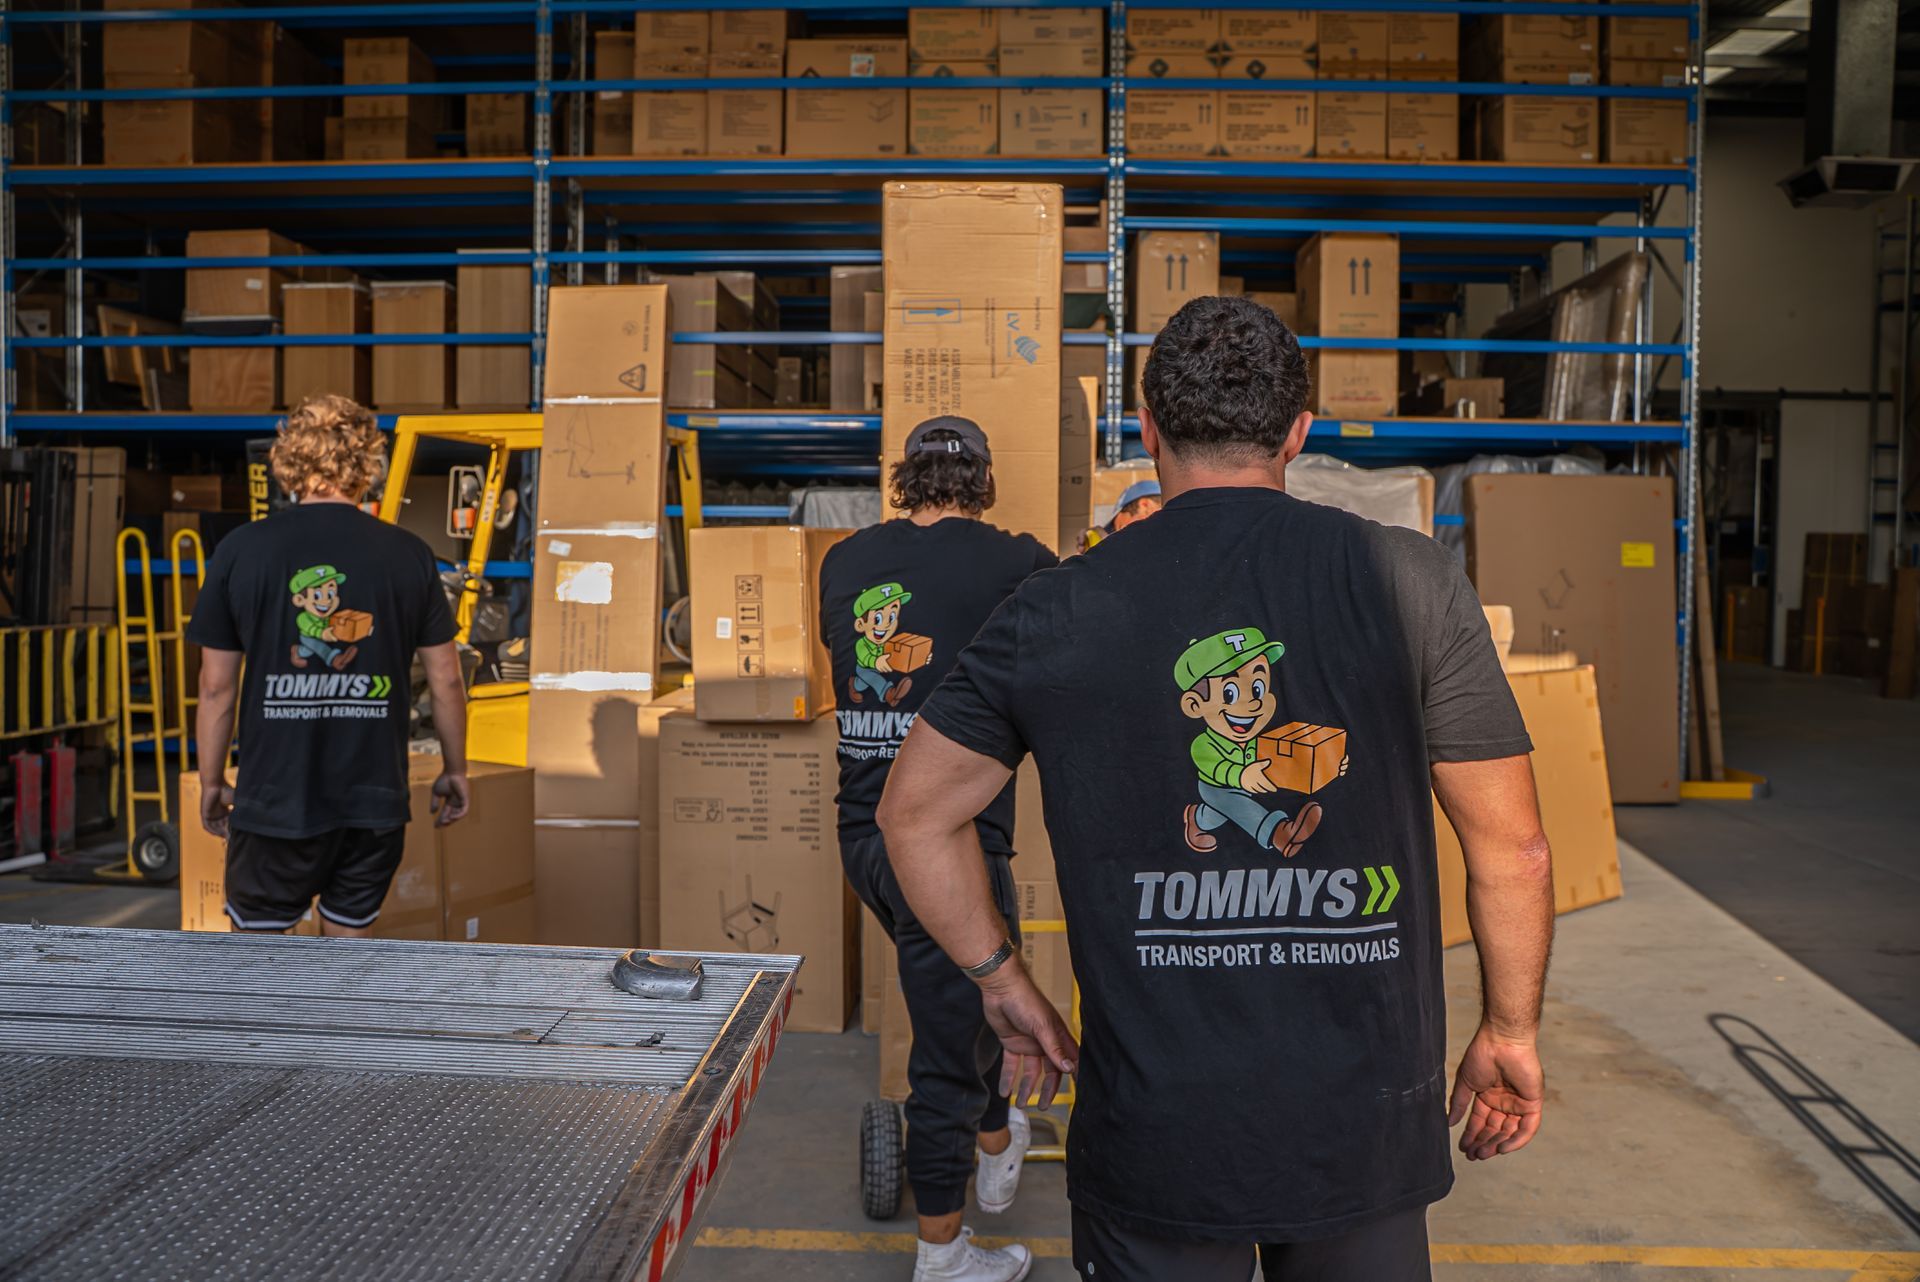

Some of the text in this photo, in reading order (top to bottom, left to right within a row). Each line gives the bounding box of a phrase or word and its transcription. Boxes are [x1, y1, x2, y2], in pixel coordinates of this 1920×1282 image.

[1007, 312, 1020, 331] LV
[904, 348, 913, 369] MADE
[916, 348, 925, 379] FACTORY
[928, 348, 937, 372] GROSS
[940, 348, 949, 376] CARTON
[952, 348, 960, 391] ASSEMBLED
[904, 381, 912, 403] CHINA
[881, 586, 891, 598] T
[1224, 634, 1246, 651] T
[265, 673, 371, 698] TOMMYS
[264, 706, 388, 720] TRANSPORT & REMOVALS
[1027, 885, 1035, 909] ASTRA
[1134, 868, 1358, 920] TOMMYS
[1025, 912, 1035, 940] FLED
[1137, 938, 1400, 967] TRANSPORT & REMOVALS
